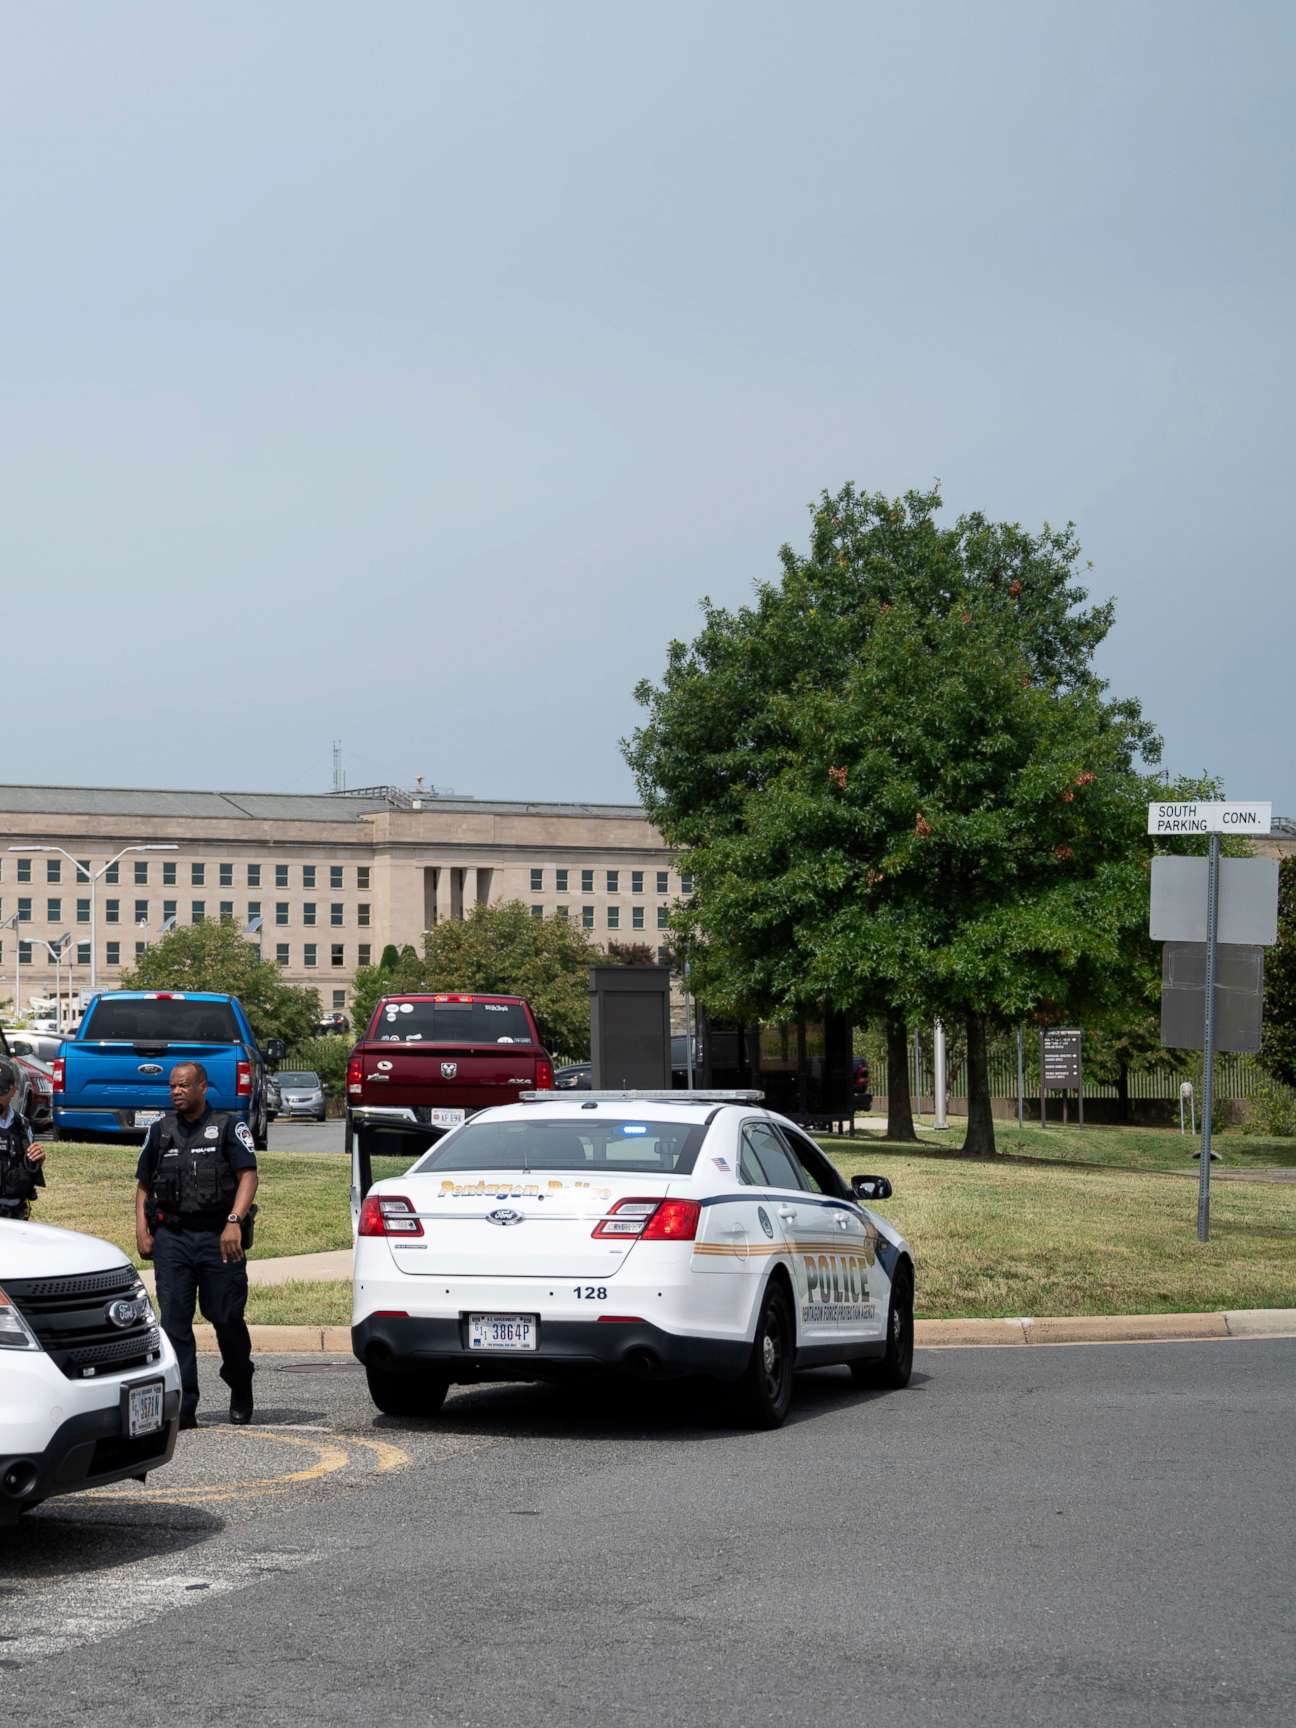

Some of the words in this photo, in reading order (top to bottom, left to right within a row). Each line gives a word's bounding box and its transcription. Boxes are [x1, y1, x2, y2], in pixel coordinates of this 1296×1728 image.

[1158, 805, 1197, 818] SOUTH
[1222, 811, 1261, 824] CONN.
[1157, 819, 1207, 832] PARKING
[437, 1179, 539, 1200] Pentagon
[803, 1255, 870, 1303] POLICE
[573, 1286, 608, 1300] 128
[492, 1323, 530, 1341] 3864P
